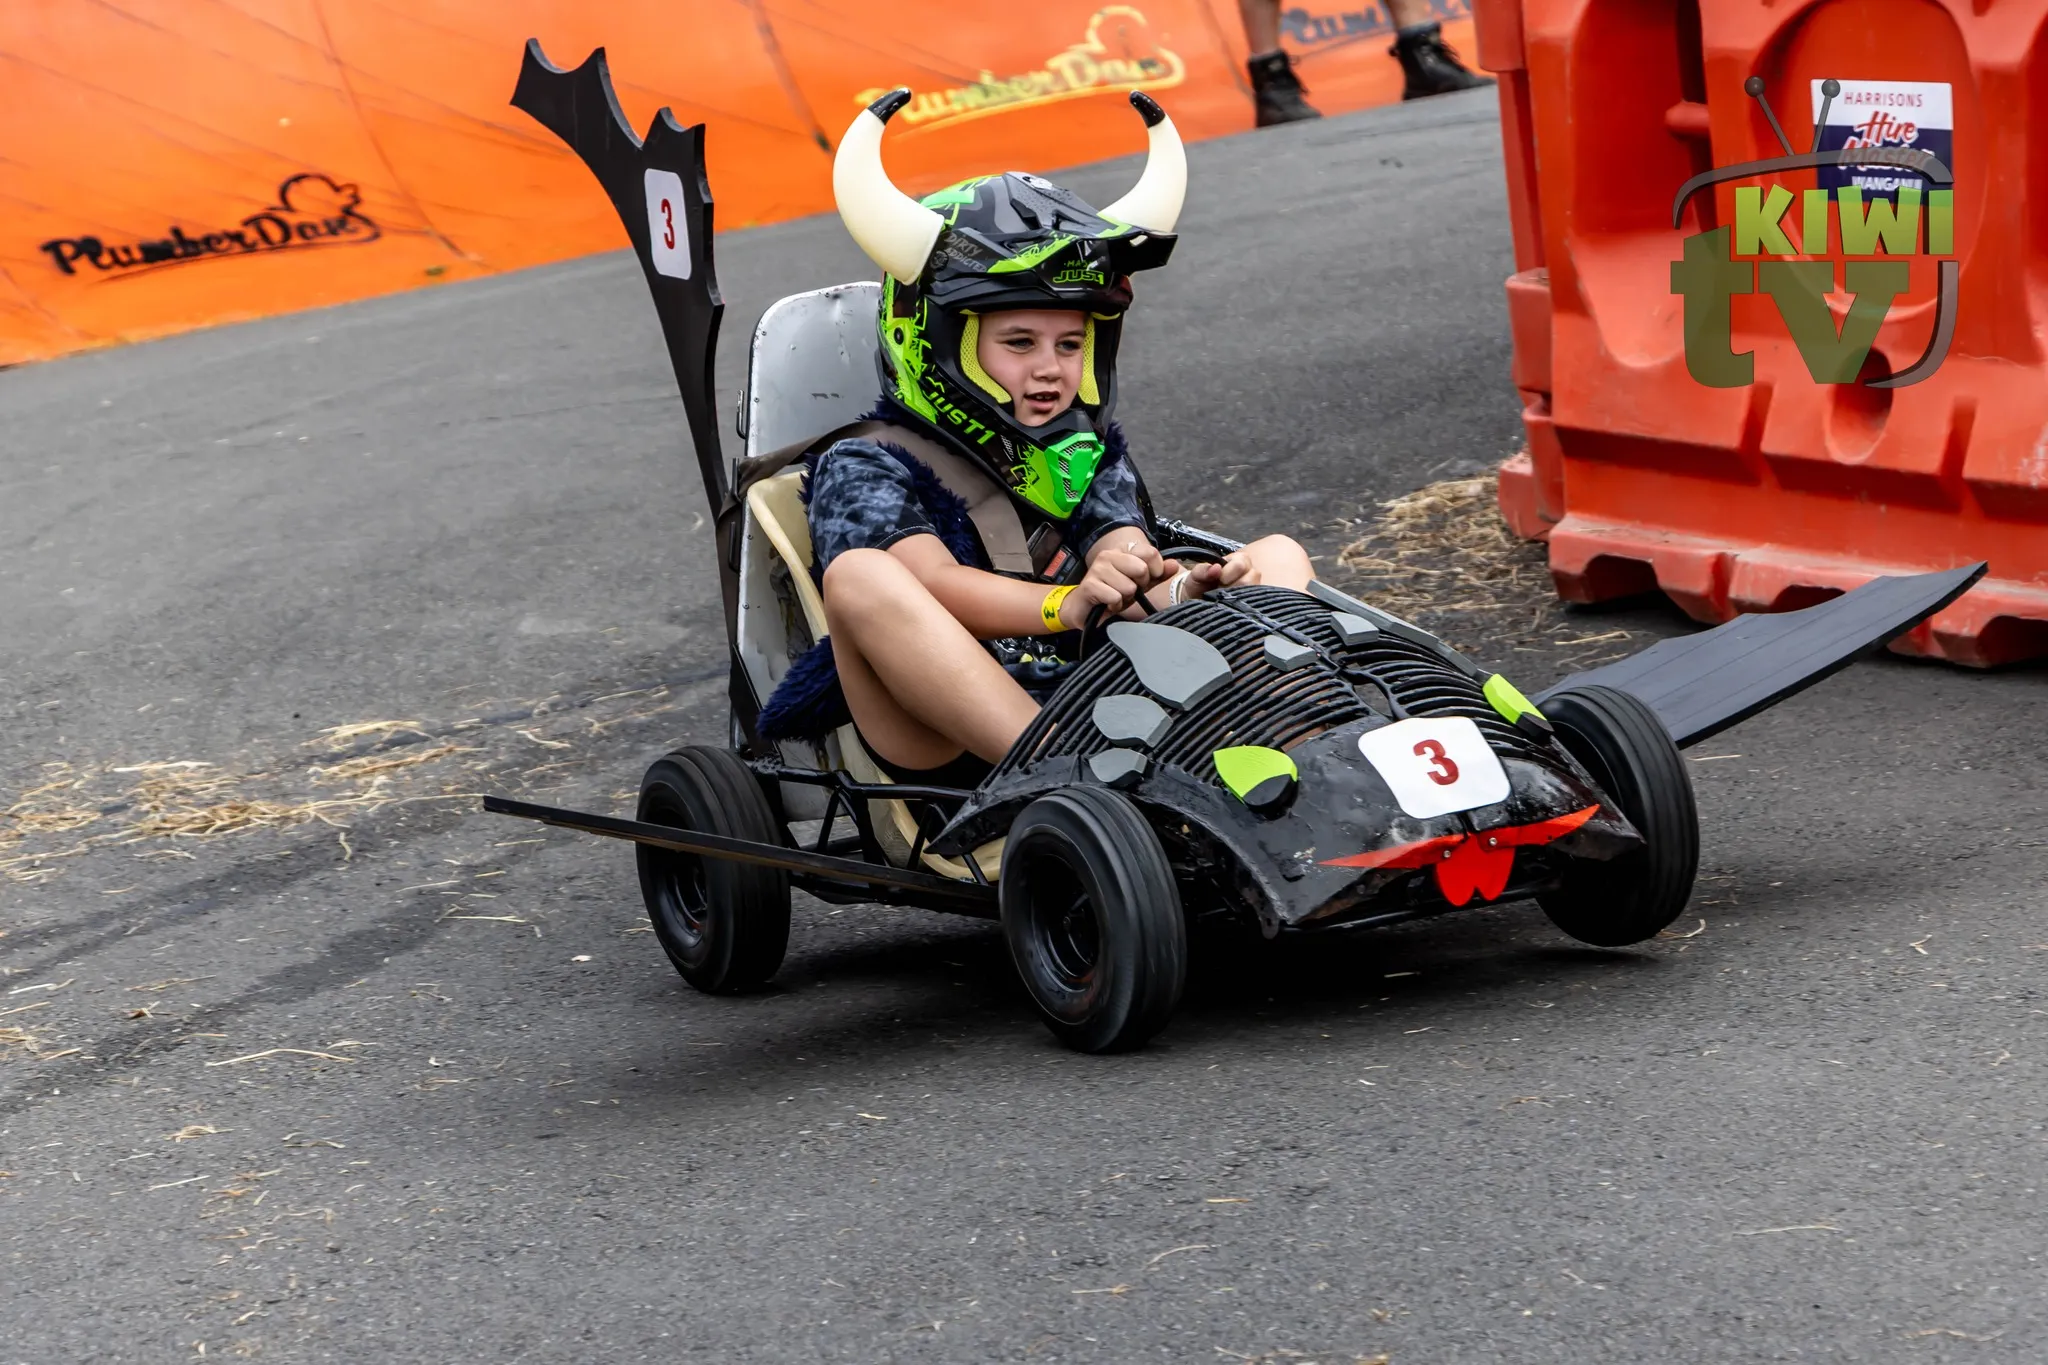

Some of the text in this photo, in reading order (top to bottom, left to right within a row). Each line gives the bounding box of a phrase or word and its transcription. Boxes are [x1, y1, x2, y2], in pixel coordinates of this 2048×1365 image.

[1843, 92, 1924, 107] HARRISONS
[1855, 110, 1917, 144] Hire
[661, 198, 676, 250] 3
[922, 391, 996, 446] JUST1
[1413, 739, 1460, 786] 3
